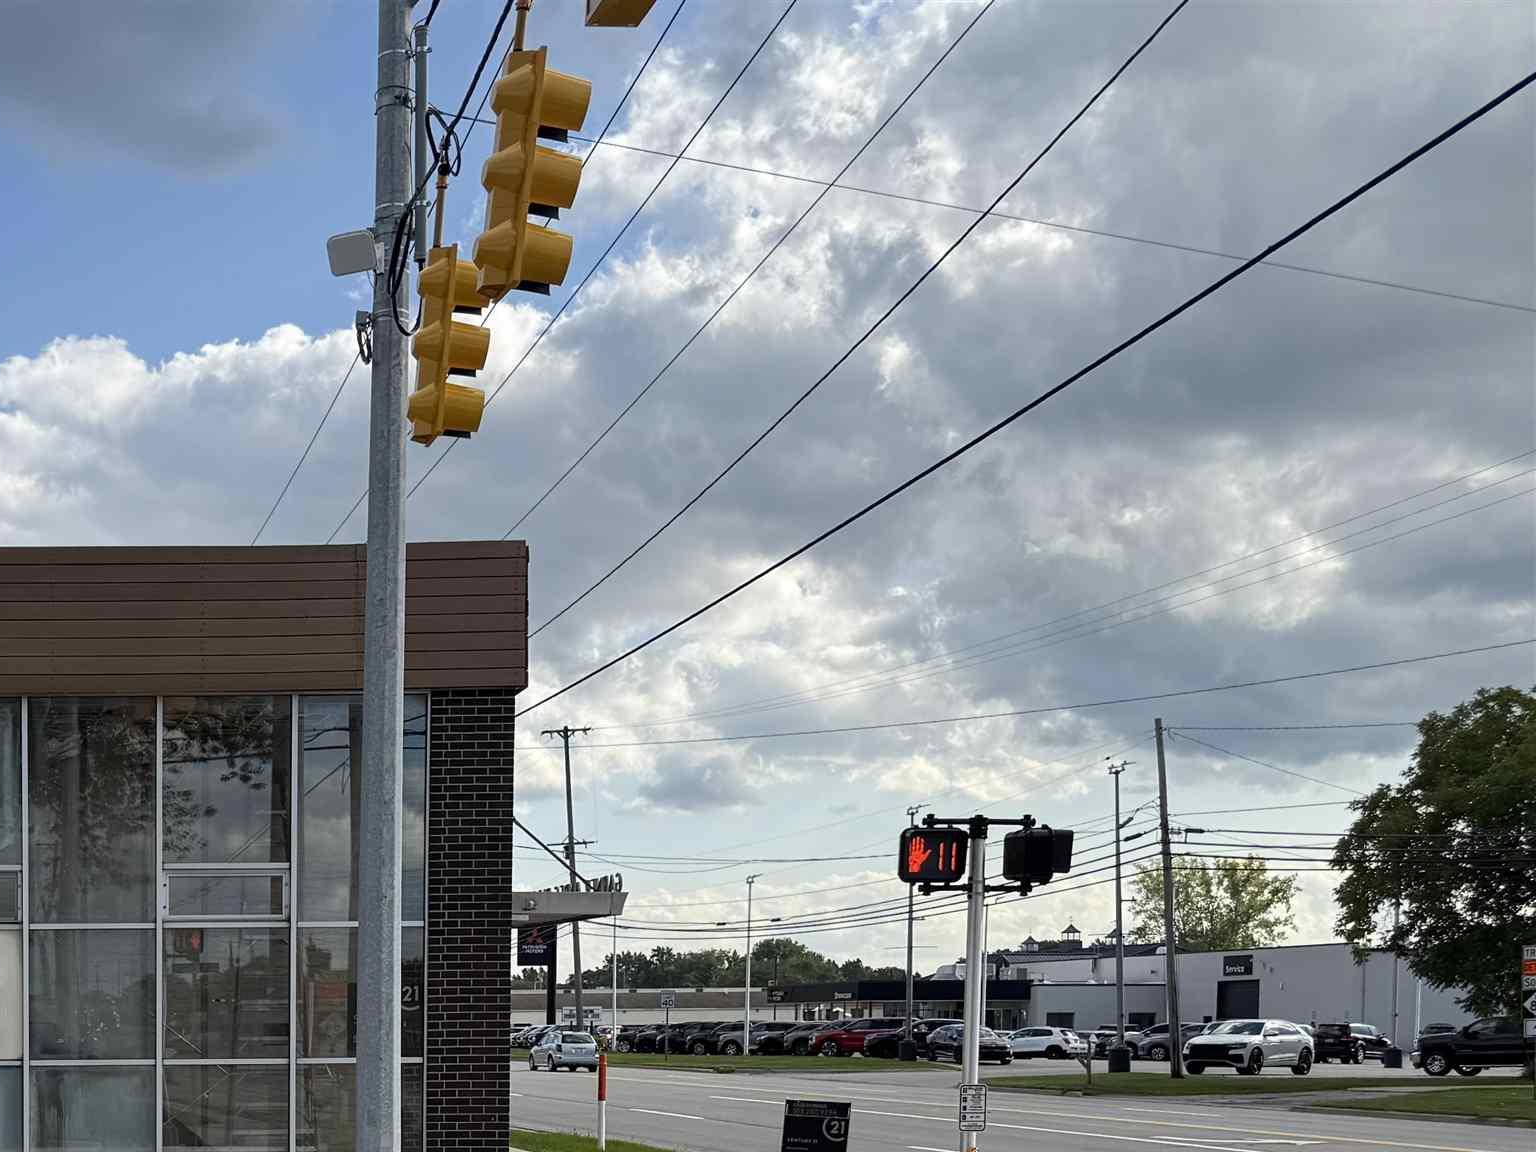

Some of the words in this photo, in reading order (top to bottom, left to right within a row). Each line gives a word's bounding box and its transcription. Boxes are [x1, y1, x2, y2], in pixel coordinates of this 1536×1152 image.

[938, 841, 957, 872] 11
[402, 985, 420, 1002] 21
[662, 999, 674, 1007] 40
